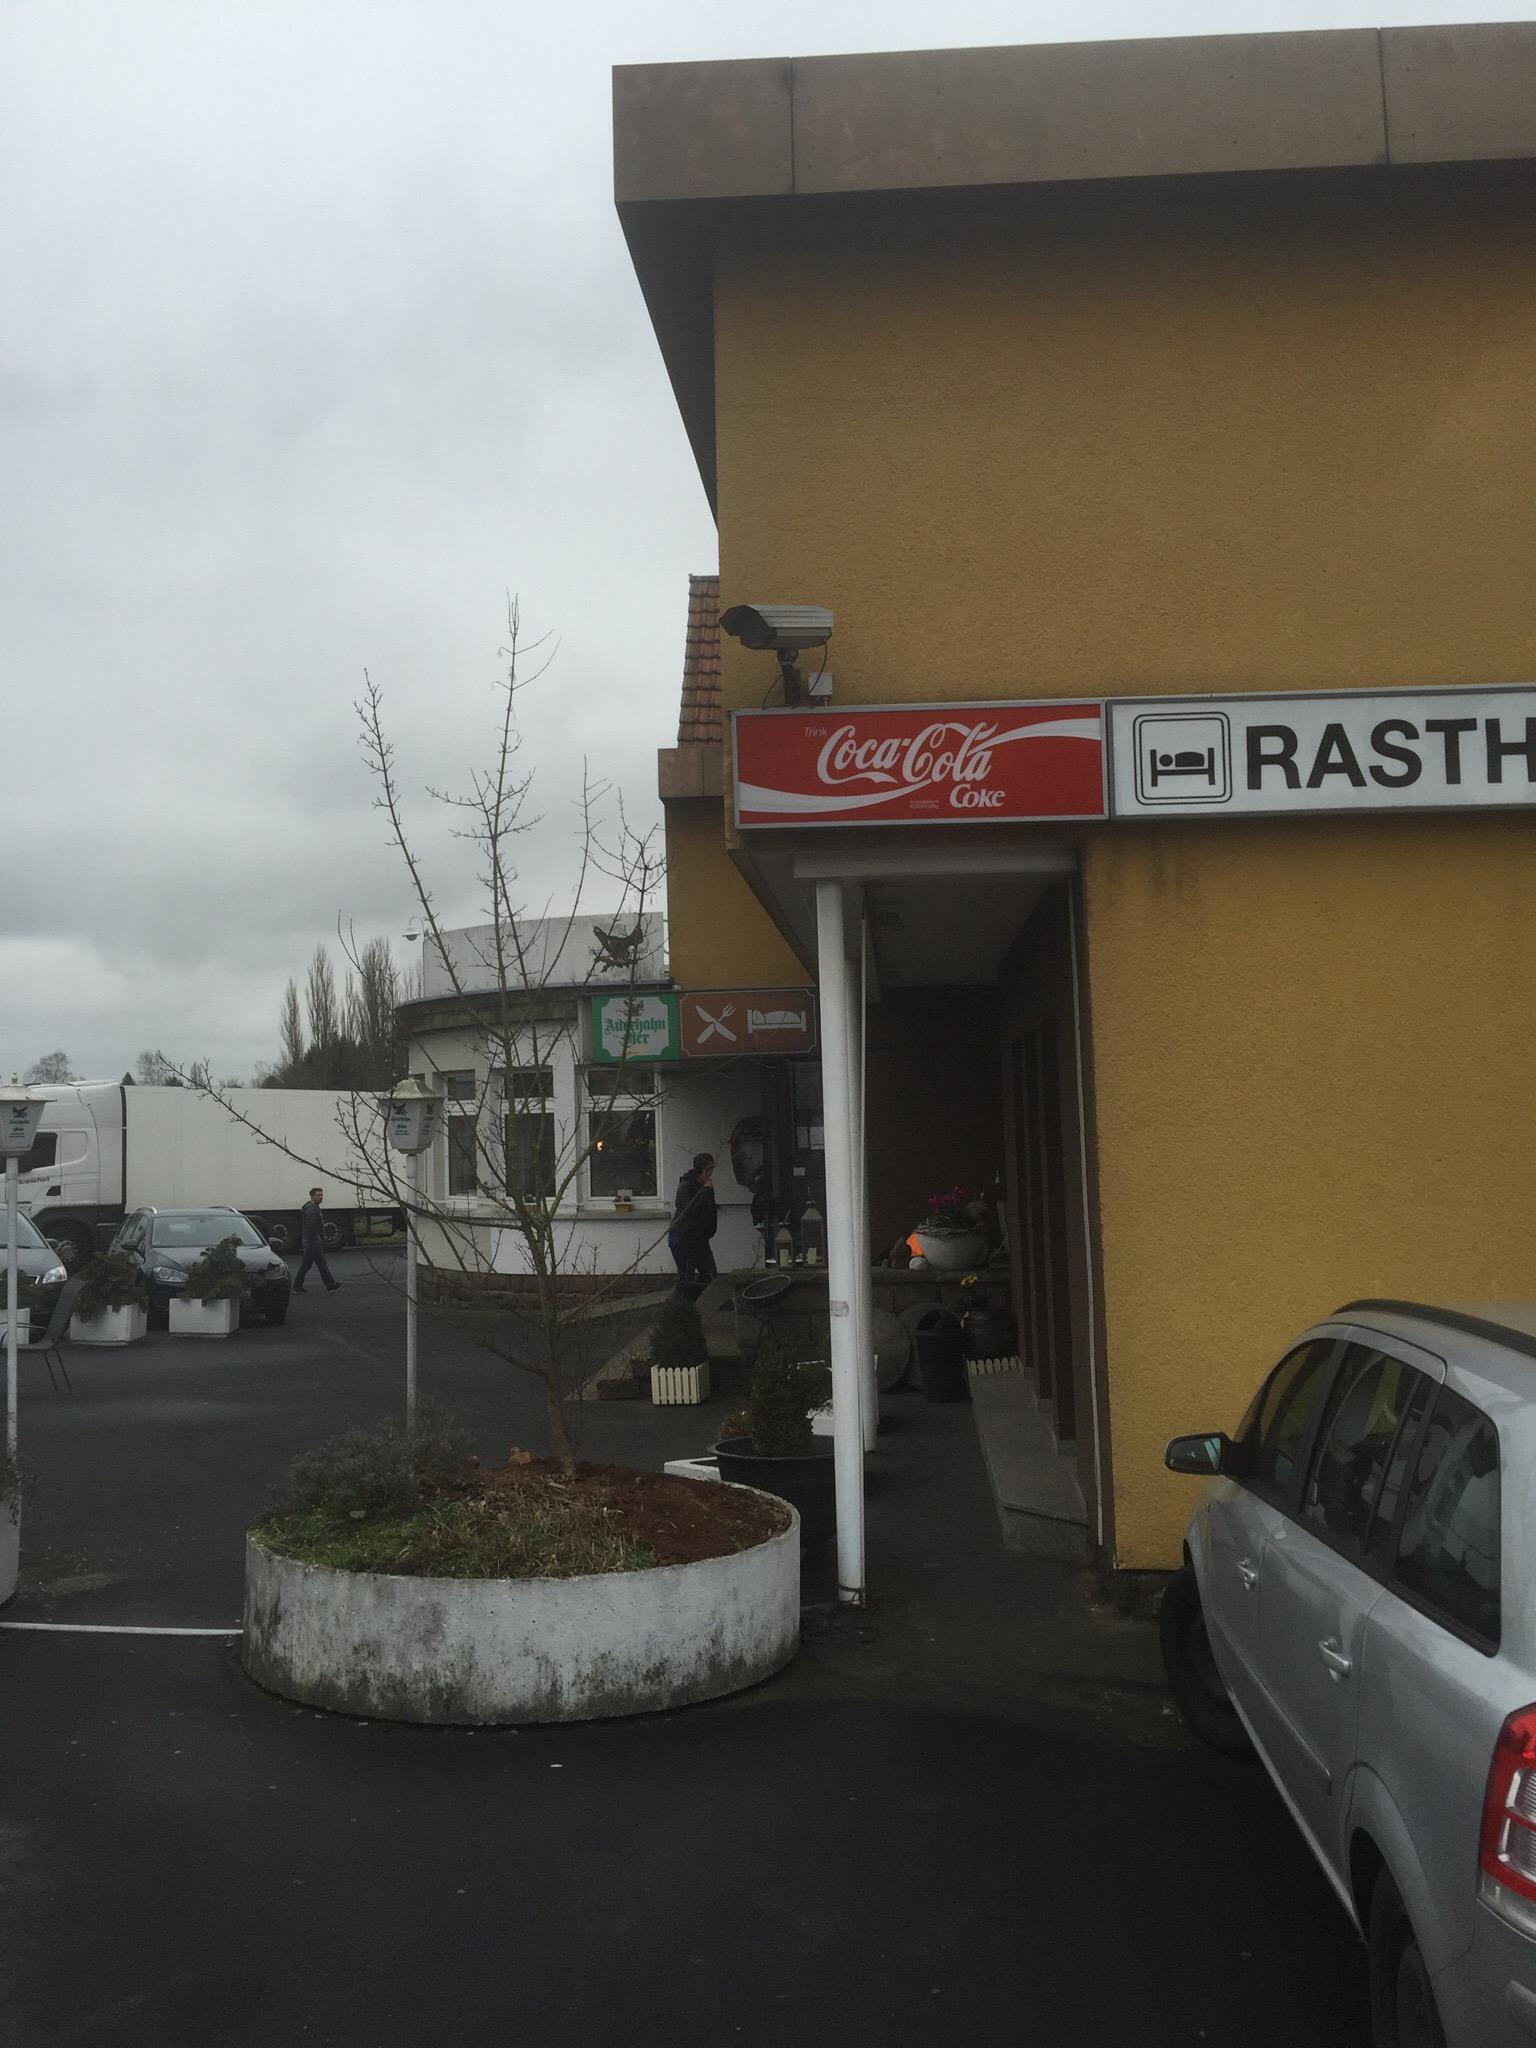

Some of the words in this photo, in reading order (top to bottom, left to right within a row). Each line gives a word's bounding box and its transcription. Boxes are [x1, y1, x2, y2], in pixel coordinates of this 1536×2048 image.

[817, 722, 998, 784] Coca-Cola
[1246, 717, 1536, 790] RASTH
[950, 783, 1005, 808] Coke
[604, 1017, 666, 1035] Auhahn
[625, 1031, 649, 1045] ier
